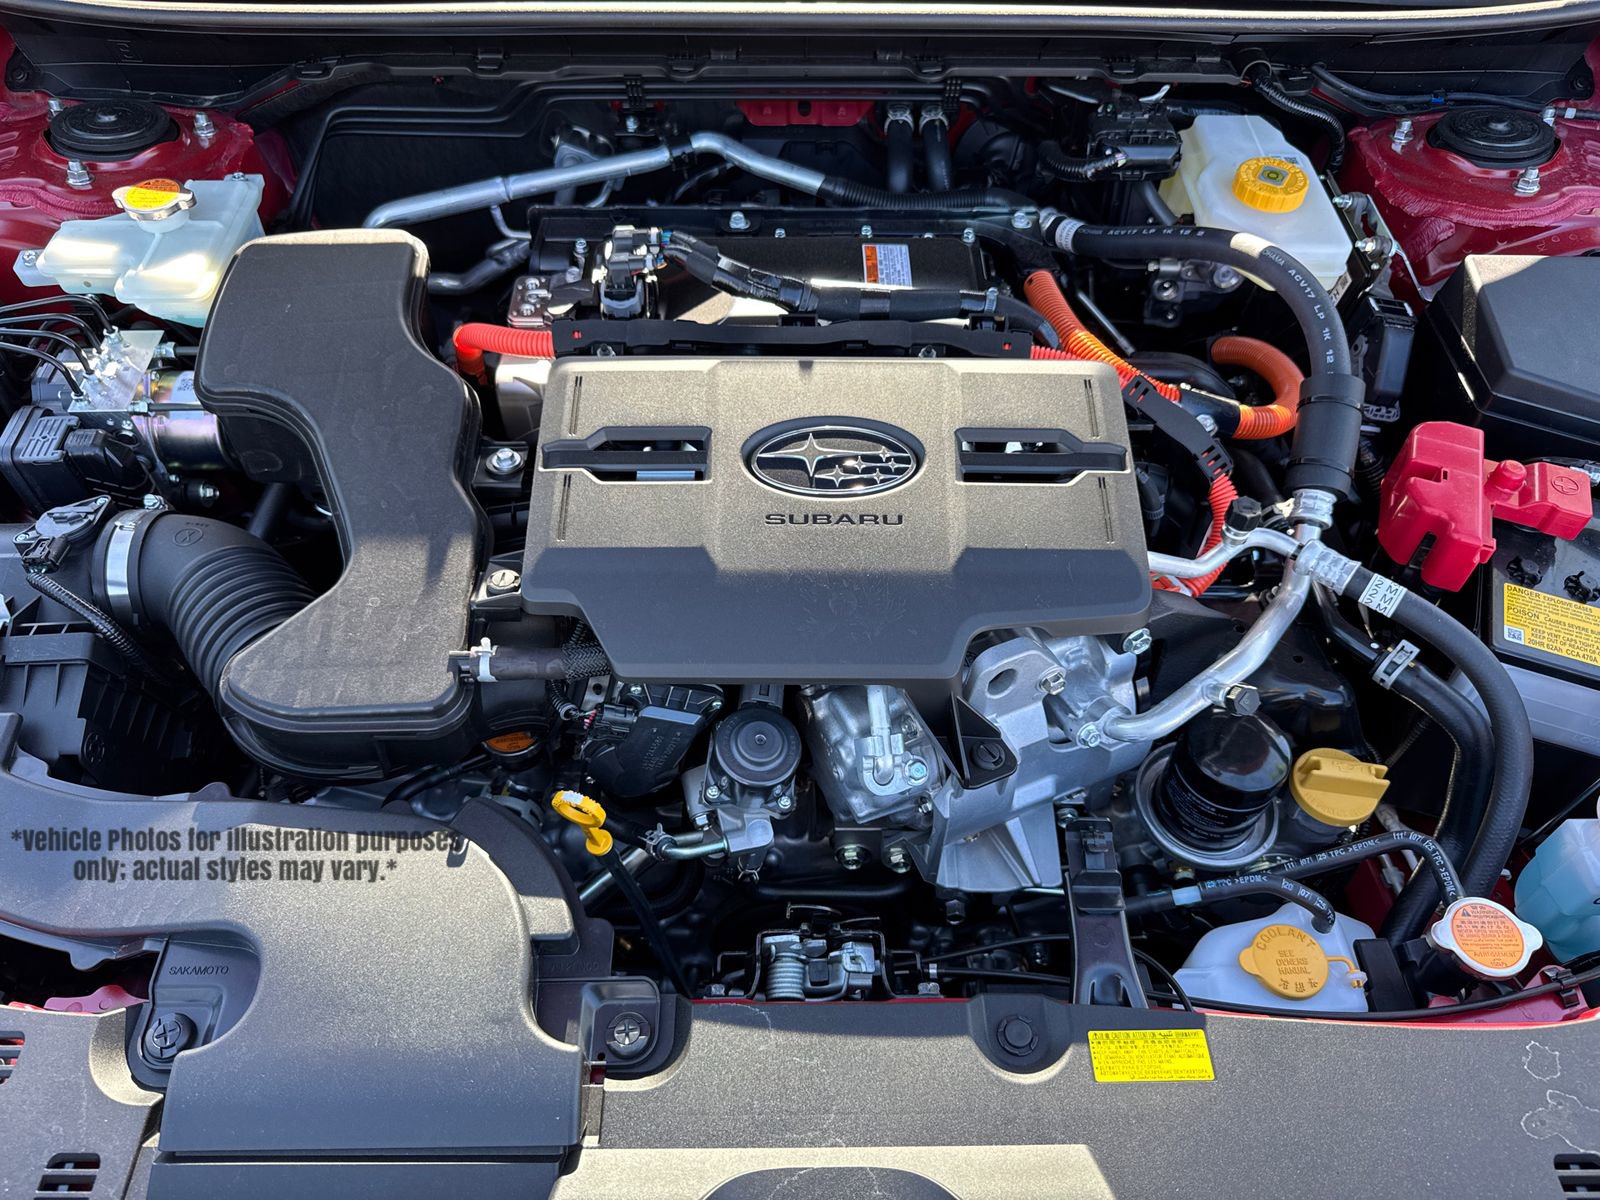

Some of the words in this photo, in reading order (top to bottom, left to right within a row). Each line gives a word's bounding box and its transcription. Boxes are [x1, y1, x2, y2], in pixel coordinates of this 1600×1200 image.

[1288, 268, 1316, 299] ACV17
[765, 514, 903, 526] SUBARU
[1374, 580, 1384, 588] 2
[1386, 585, 1399, 596] M
[1506, 584, 1540, 600] DANGER
[1543, 596, 1573, 608] EXPLOSIVE
[1368, 588, 1378, 598] 2
[1380, 594, 1394, 606] M
[1506, 605, 1540, 620] POISON
[1565, 649, 1581, 658] CCA
[1330, 848, 1346, 856] TPC
[1432, 850, 1444, 866] TPC
[1256, 926, 1316, 951] COOLANT
[168, 966, 229, 976] SAKAMOTO
